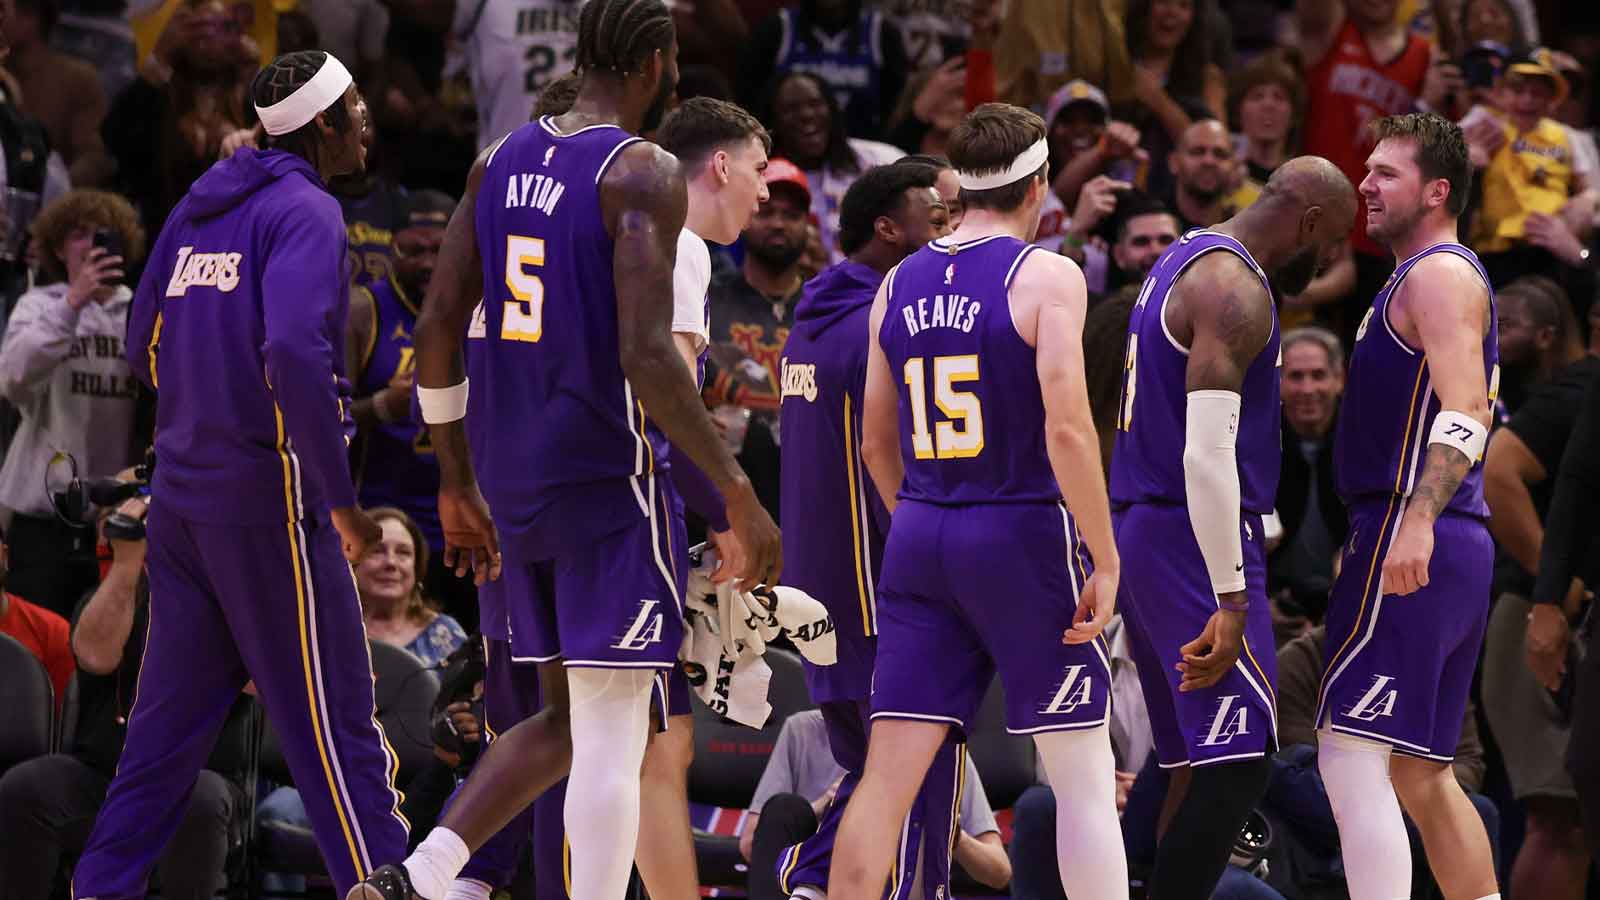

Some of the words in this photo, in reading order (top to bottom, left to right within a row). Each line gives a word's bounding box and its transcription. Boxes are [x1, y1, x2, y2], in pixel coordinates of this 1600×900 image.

[505, 173, 565, 217] AYTON
[500, 234, 545, 343] 5
[902, 294, 981, 337] REAVES
[903, 354, 985, 460] 15
[1444, 421, 1474, 444] 77
[611, 599, 665, 651] LA
[1038, 664, 1092, 714] LA
[1341, 673, 1399, 722] LA
[1197, 694, 1250, 747] LA
